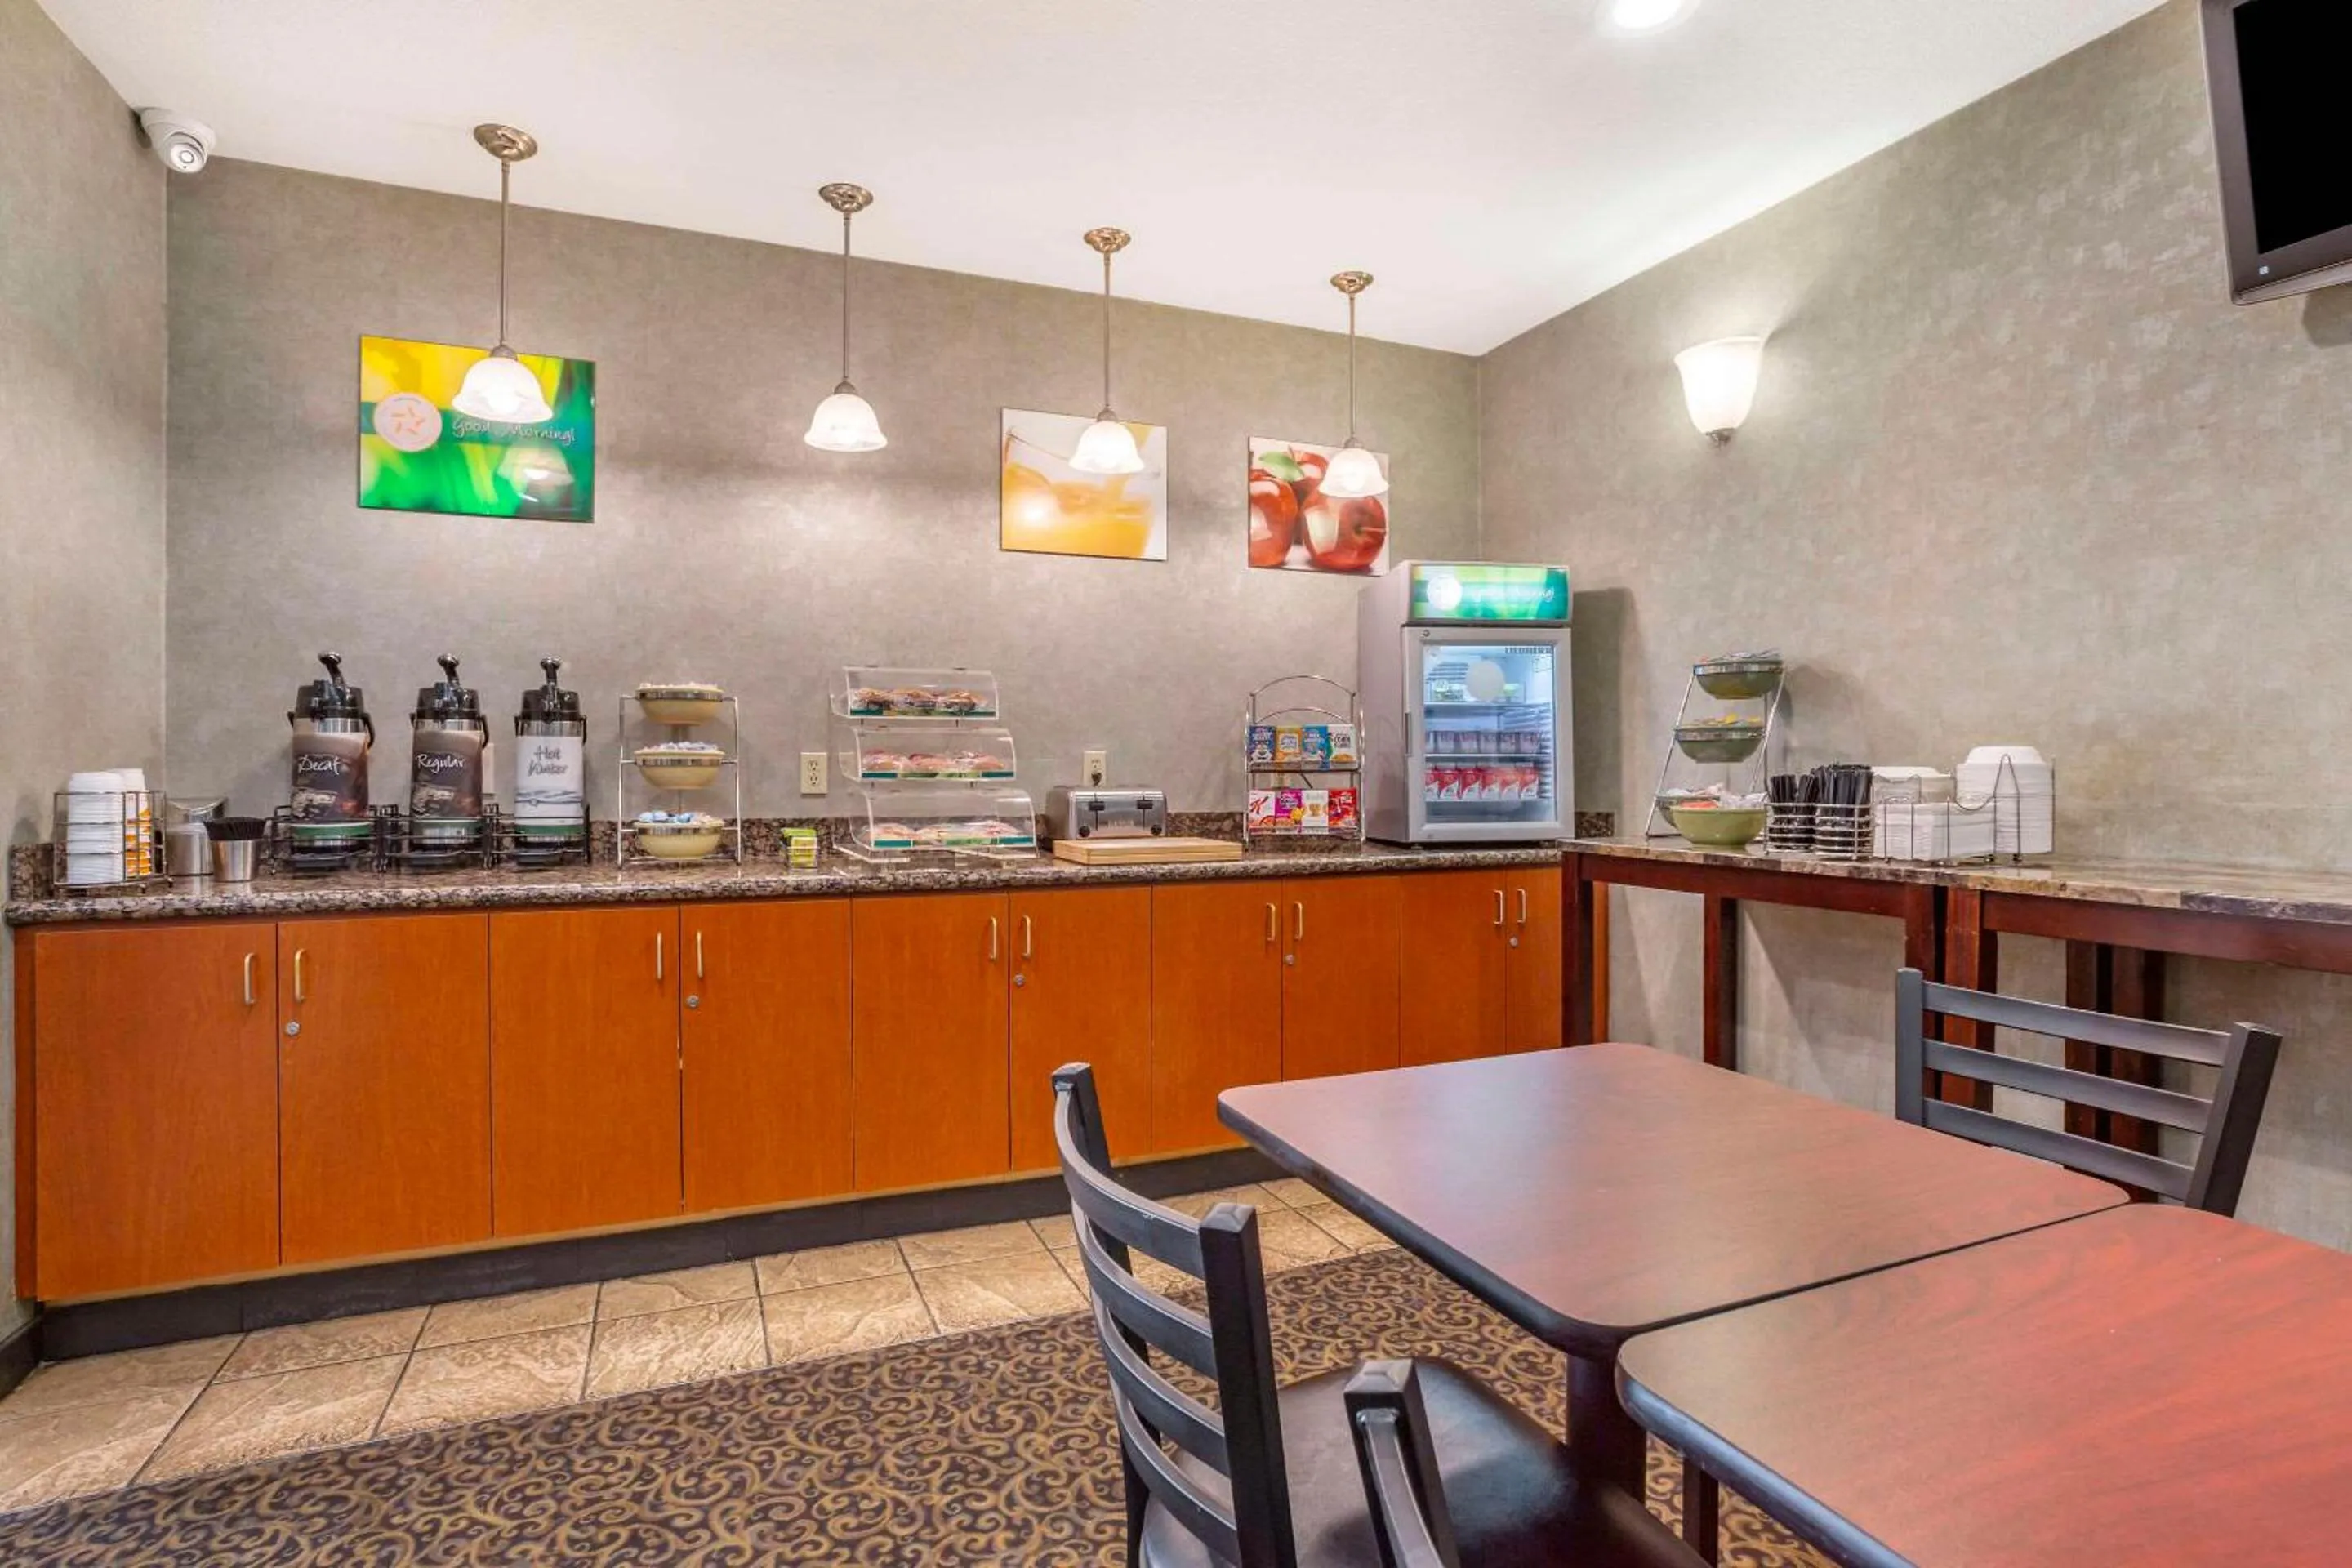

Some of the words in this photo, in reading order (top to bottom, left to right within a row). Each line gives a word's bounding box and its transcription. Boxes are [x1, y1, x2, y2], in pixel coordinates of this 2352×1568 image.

[452, 416, 490, 438] Good
[297, 755, 341, 776] Decaf
[416, 753, 466, 773] Regular
